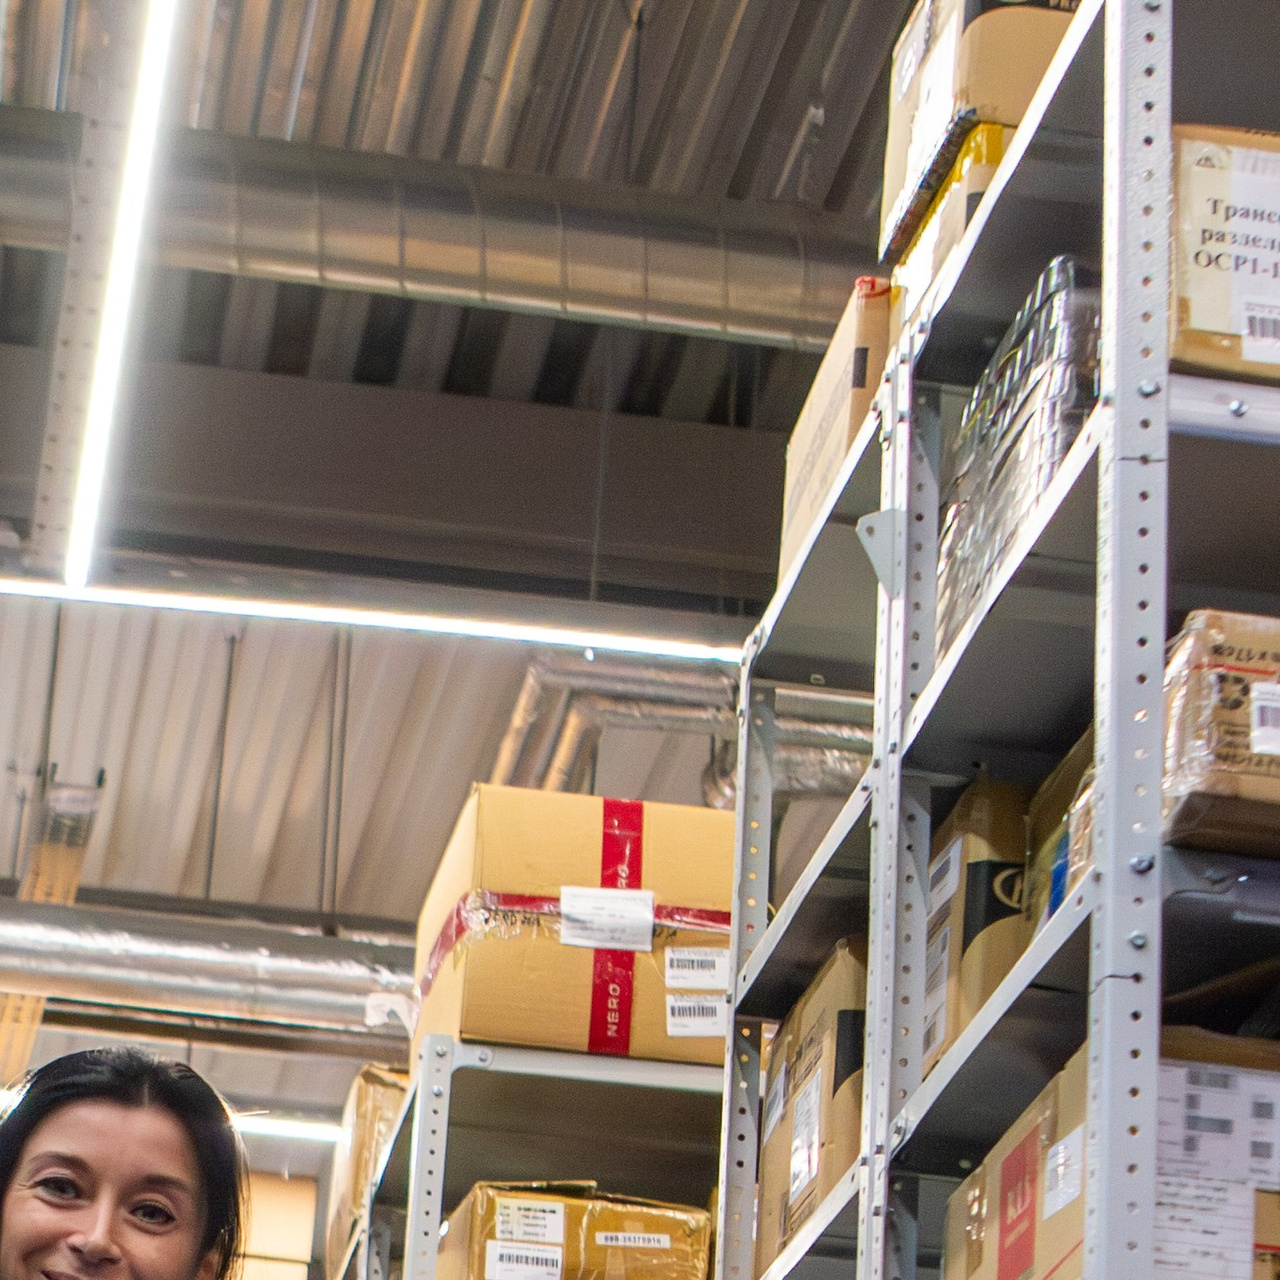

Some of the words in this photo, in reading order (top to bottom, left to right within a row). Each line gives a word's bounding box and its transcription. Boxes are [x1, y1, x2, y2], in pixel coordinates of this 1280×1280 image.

[1206, 197, 1280, 223] Транс
[1201, 228, 1280, 250] раздел
[606, 983, 620, 1037] NERO
